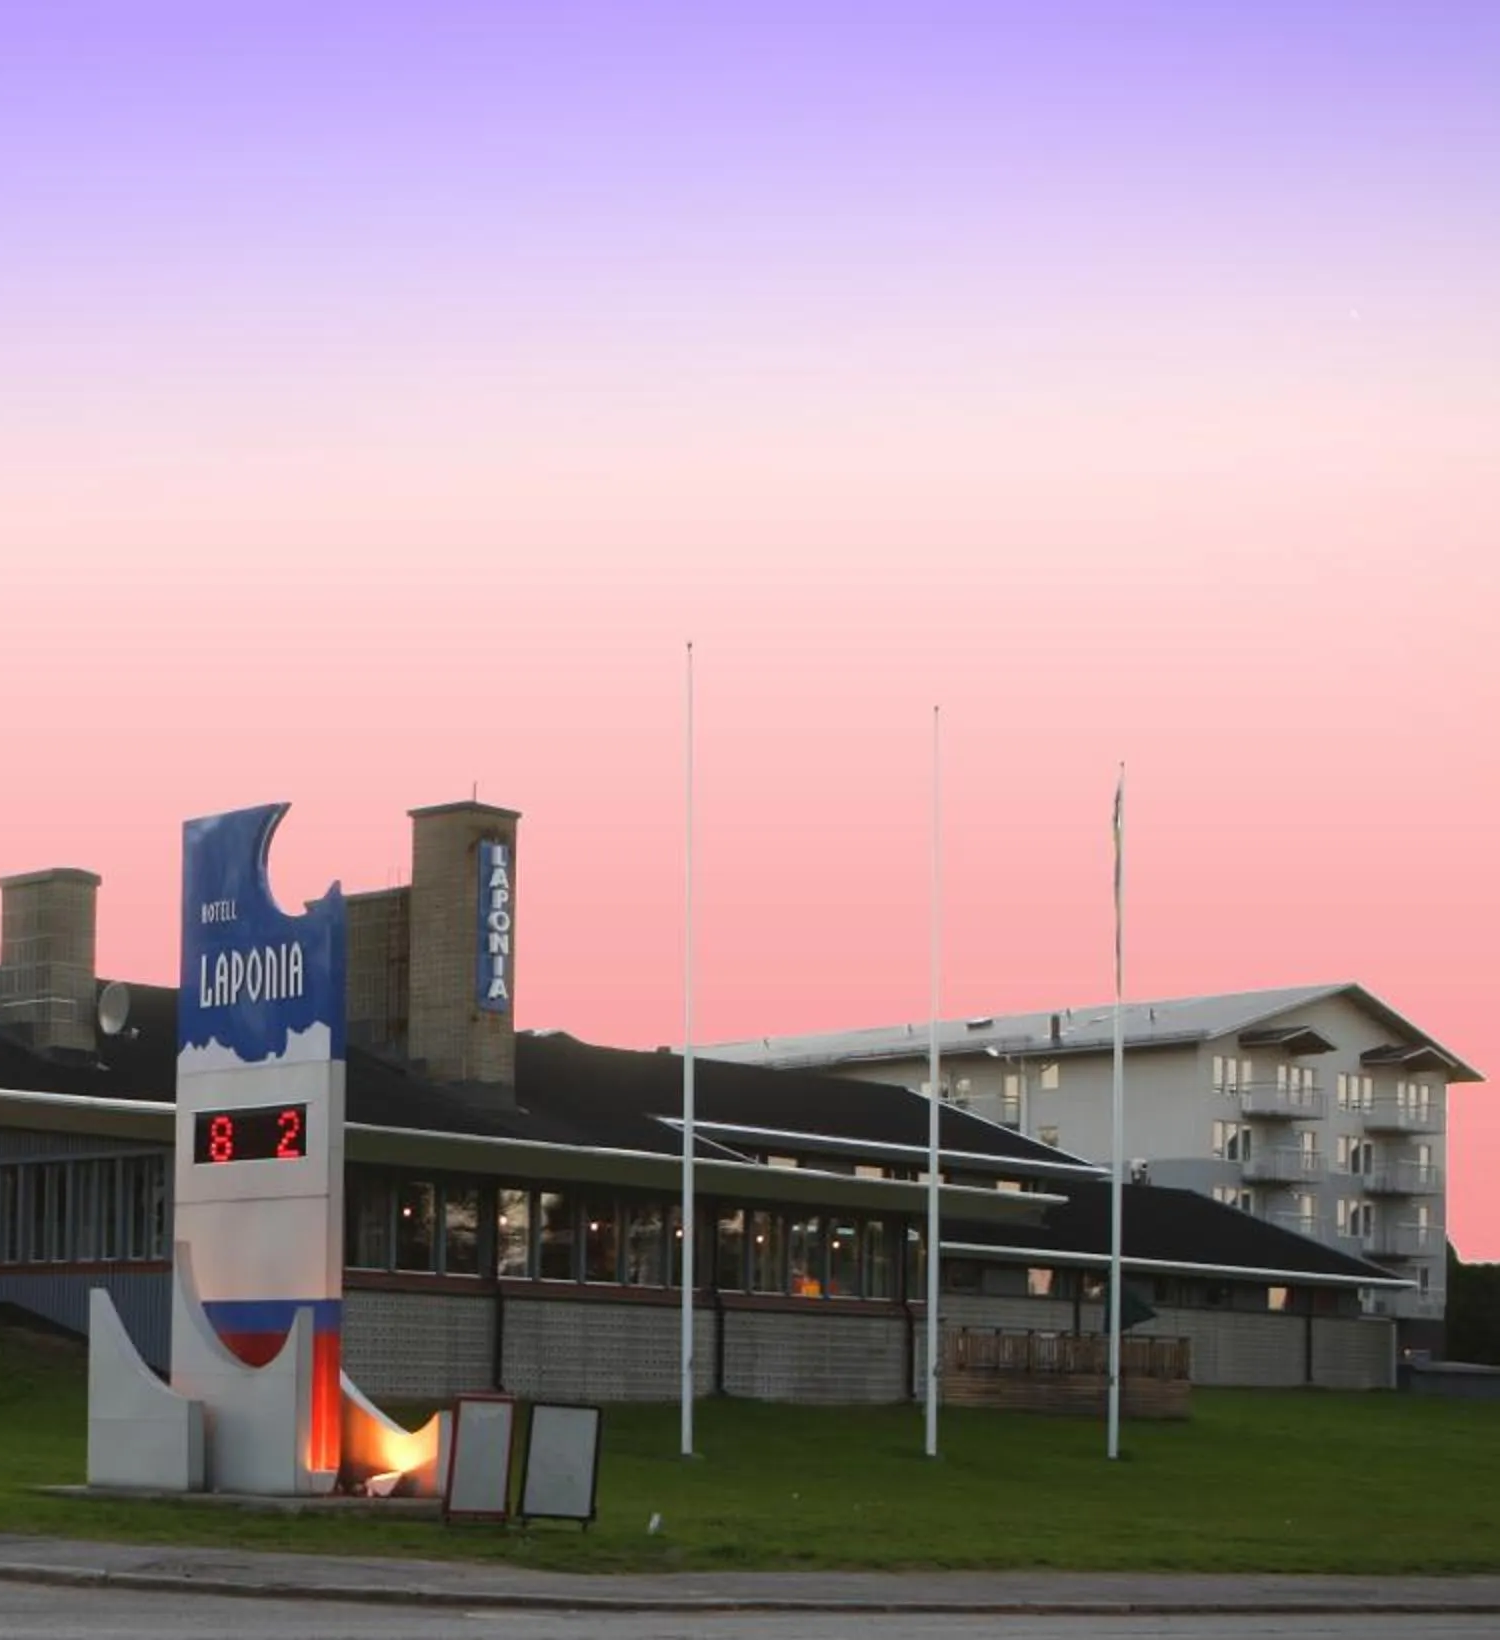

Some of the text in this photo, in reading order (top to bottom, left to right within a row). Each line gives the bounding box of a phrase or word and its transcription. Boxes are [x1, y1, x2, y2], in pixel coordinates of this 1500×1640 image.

[202, 900, 237, 924] HOTELL
[487, 845, 510, 999] LAPONIA
[201, 941, 303, 1008] LAPONIA
[210, 1110, 301, 1163] 8 2
